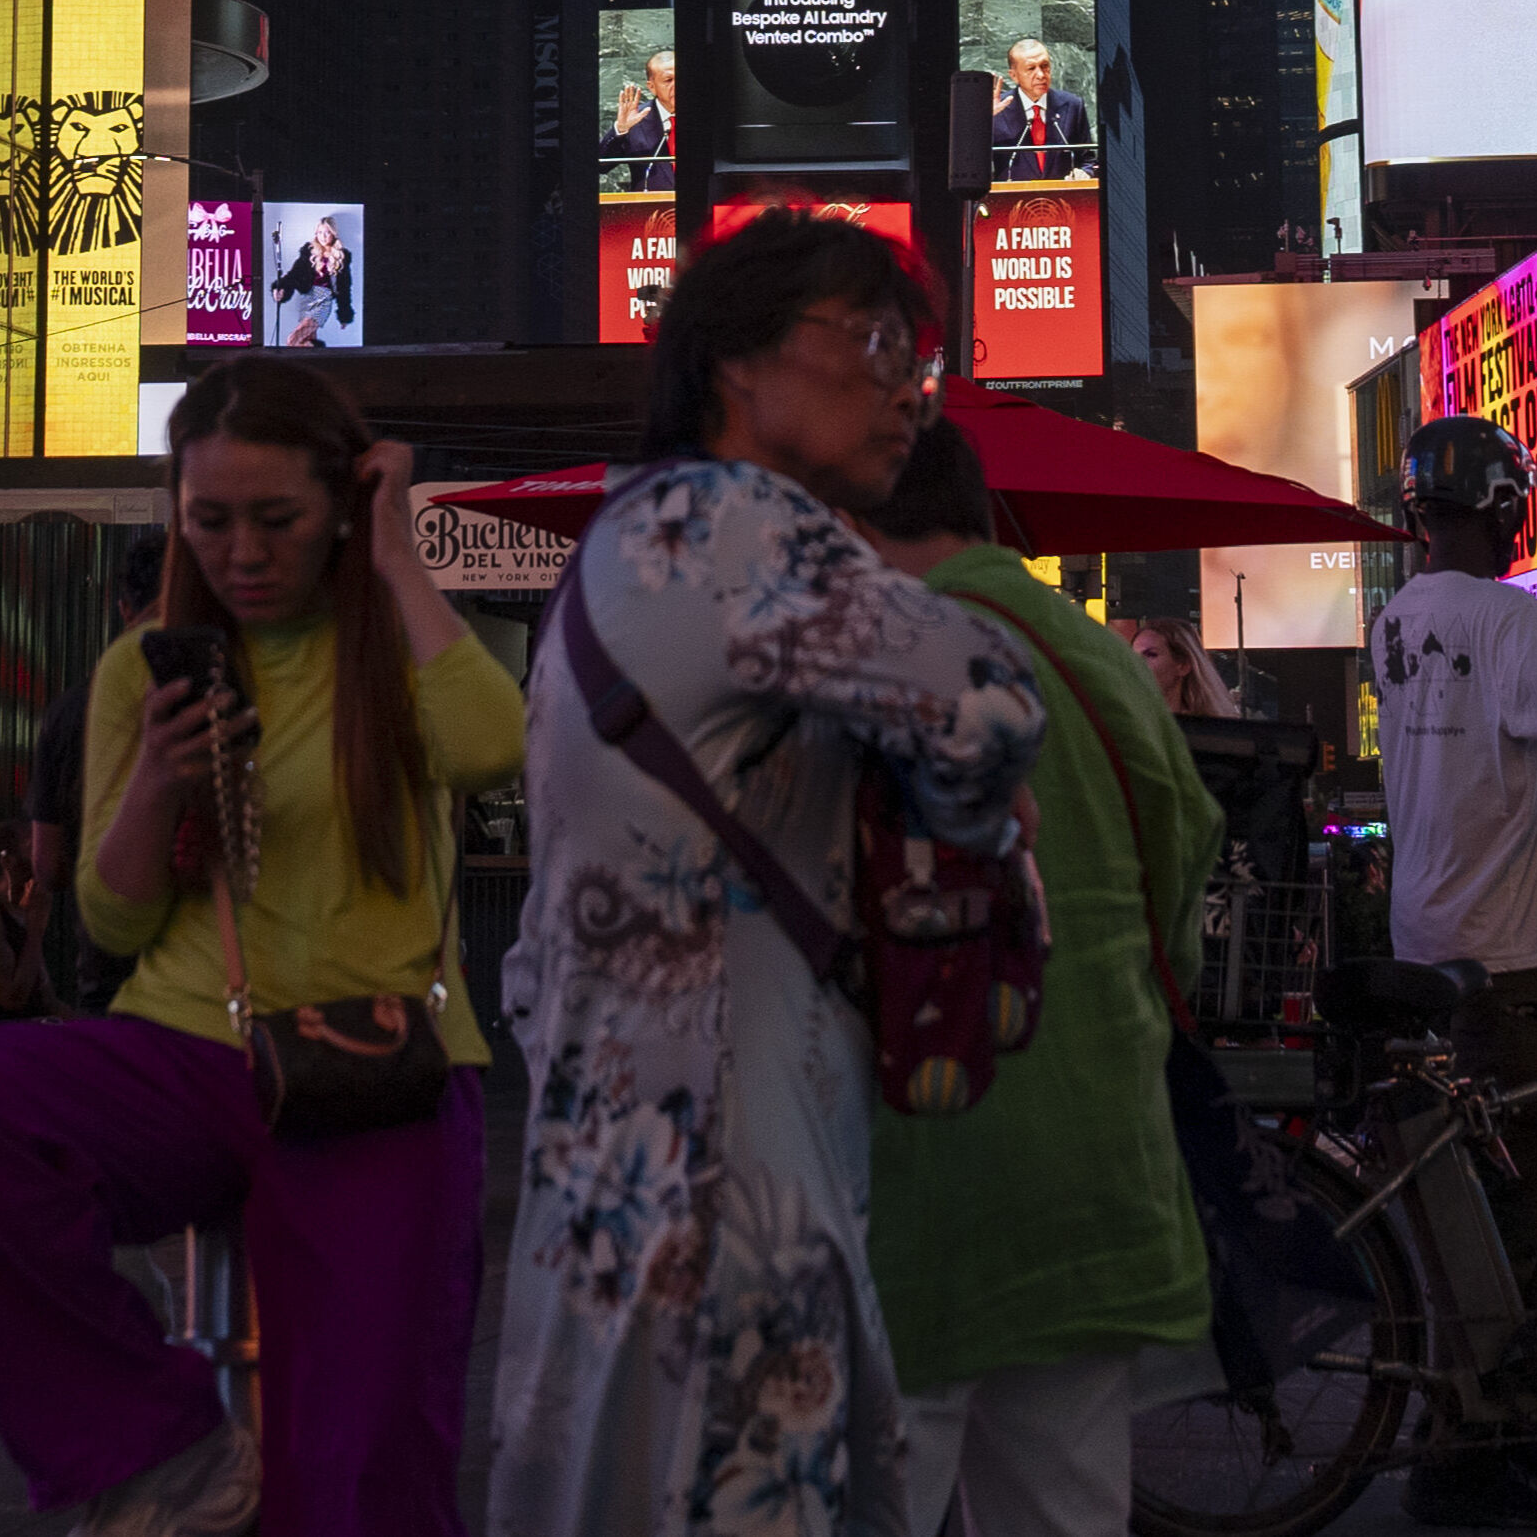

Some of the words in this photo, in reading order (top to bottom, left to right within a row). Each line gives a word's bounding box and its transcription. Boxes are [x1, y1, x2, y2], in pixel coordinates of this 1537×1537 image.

[732, 11, 800, 29] Bespoke
[803, 11, 819, 25] AI
[821, 10, 887, 28] Laundry
[746, 29, 802, 44] Vented
[996, 228, 1008, 250] A
[1012, 227, 1072, 250] FAIRER
[631, 238, 643, 260] A
[54, 270, 76, 286] THE
[80, 270, 135, 286] WORLD'S
[187, 248, 243, 290] BELLA
[627, 267, 674, 289] WORL
[991, 258, 1052, 280] WORLD
[1055, 257, 1072, 279] IS
[70, 286, 136, 306] MUSICAL
[994, 286, 1075, 310] POSSIBLE
[1444, 323, 1459, 367] THE
[1461, 309, 1478, 356] NEW
[1481, 296, 1503, 344] YORK
[63, 343, 126, 354] OBTENHA
[57, 357, 132, 369] INGRESSOS
[78, 372, 111, 382] AQUI
[1447, 359, 1477, 417] FILM
[463, 553, 502, 568] DEL
[512, 553, 571, 568] VINO
[463, 573, 487, 581] NEW
[497, 573, 530, 581] YORK
[540, 572, 560, 581] CIT
